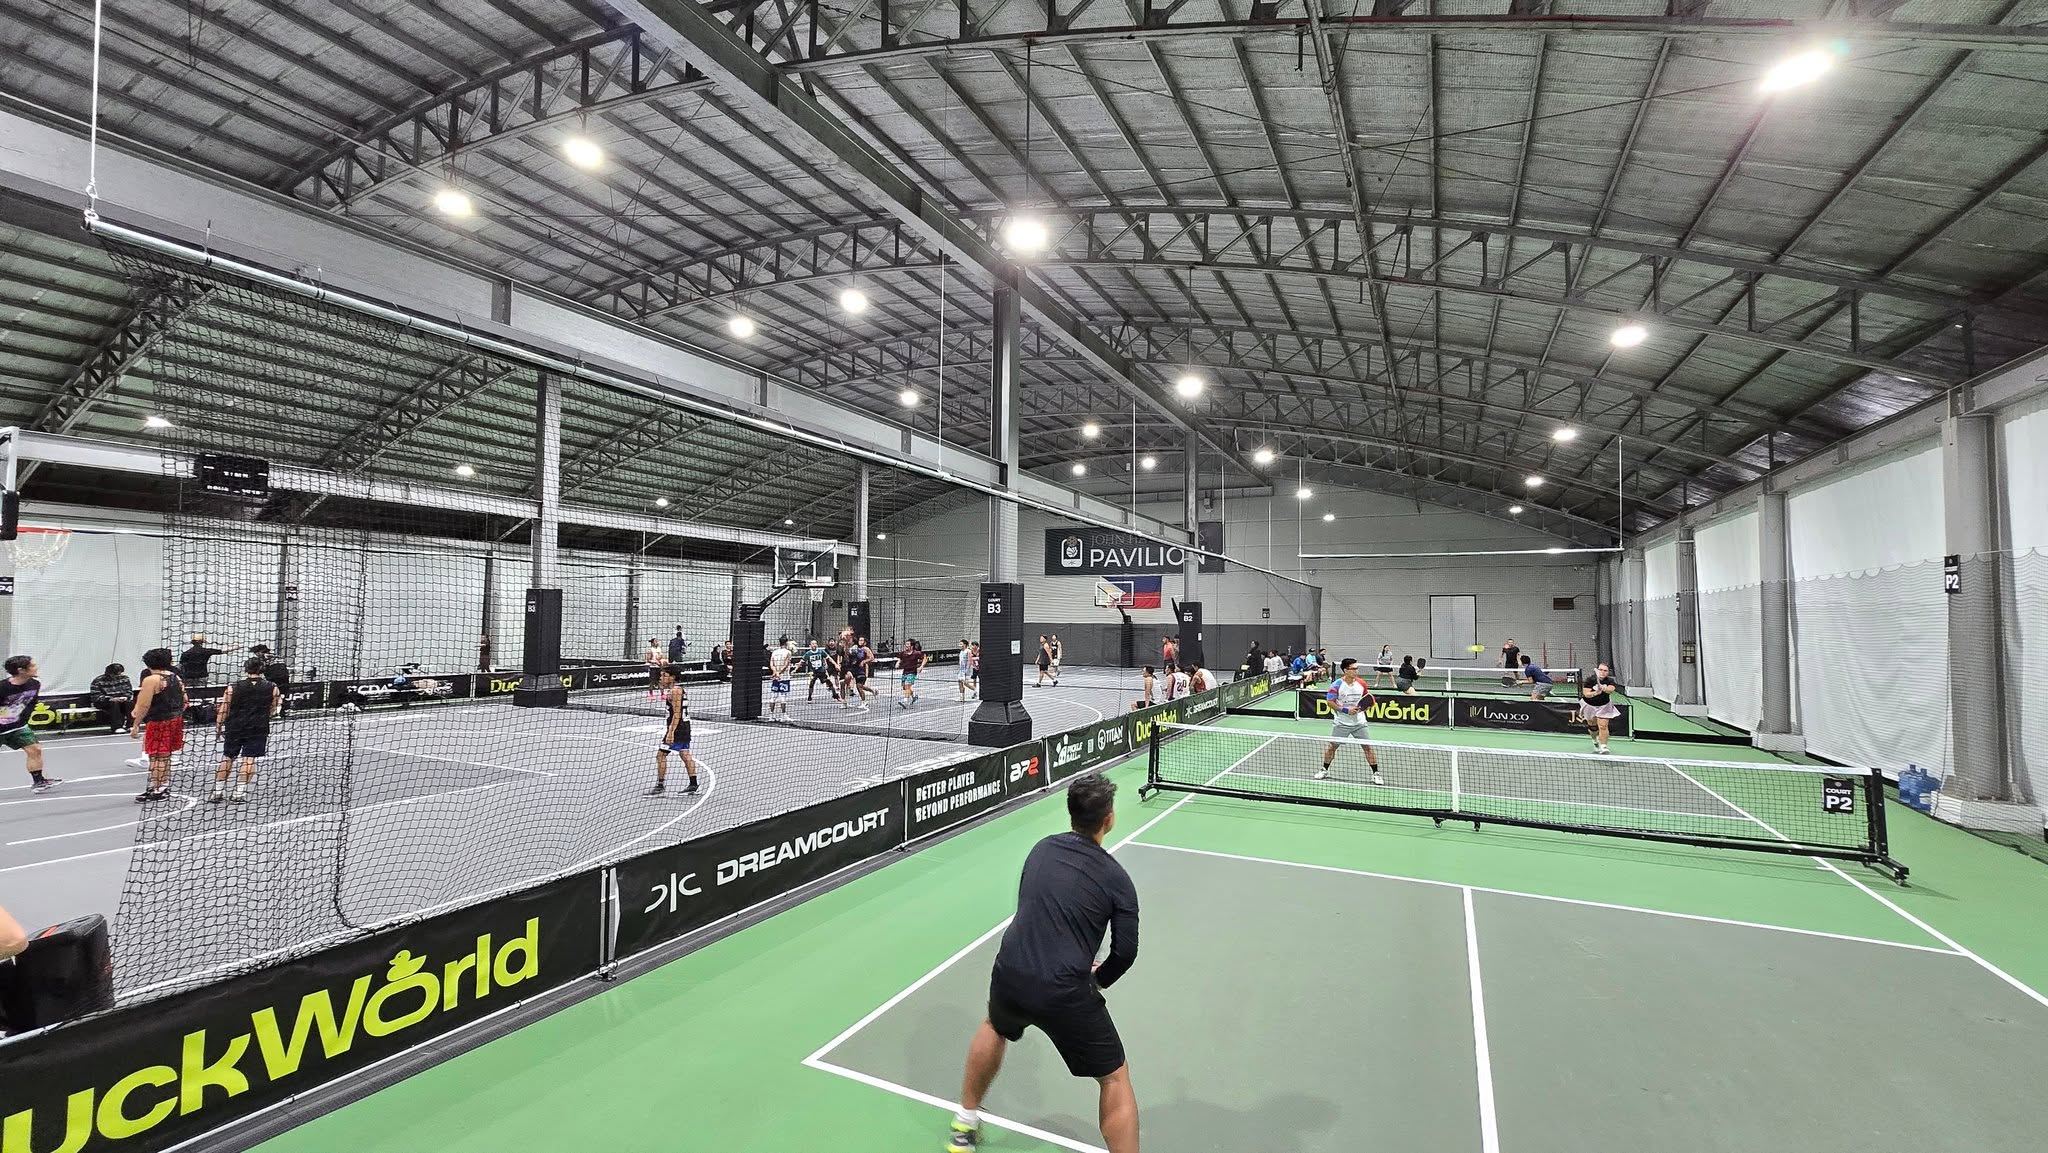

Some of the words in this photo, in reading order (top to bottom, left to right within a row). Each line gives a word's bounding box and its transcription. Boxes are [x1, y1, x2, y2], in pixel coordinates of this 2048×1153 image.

[1945, 574, 1960, 589] P2
[987, 603, 1001, 614] B3
[1316, 699, 1430, 721] DWorld
[1105, 725, 1123, 743] TITAN
[1136, 709, 1177, 742] DucWorld
[915, 779, 947, 803] BETTER
[947, 771, 975, 792] PLAYER
[1825, 787, 1852, 795] COURT
[915, 799, 949, 823] BEYOND
[949, 779, 1001, 811] PERFORMANCE
[1826, 795, 1853, 811] P2
[716, 808, 890, 887] DREAMCOURT
[2, 916, 539, 1153] uckWorld
